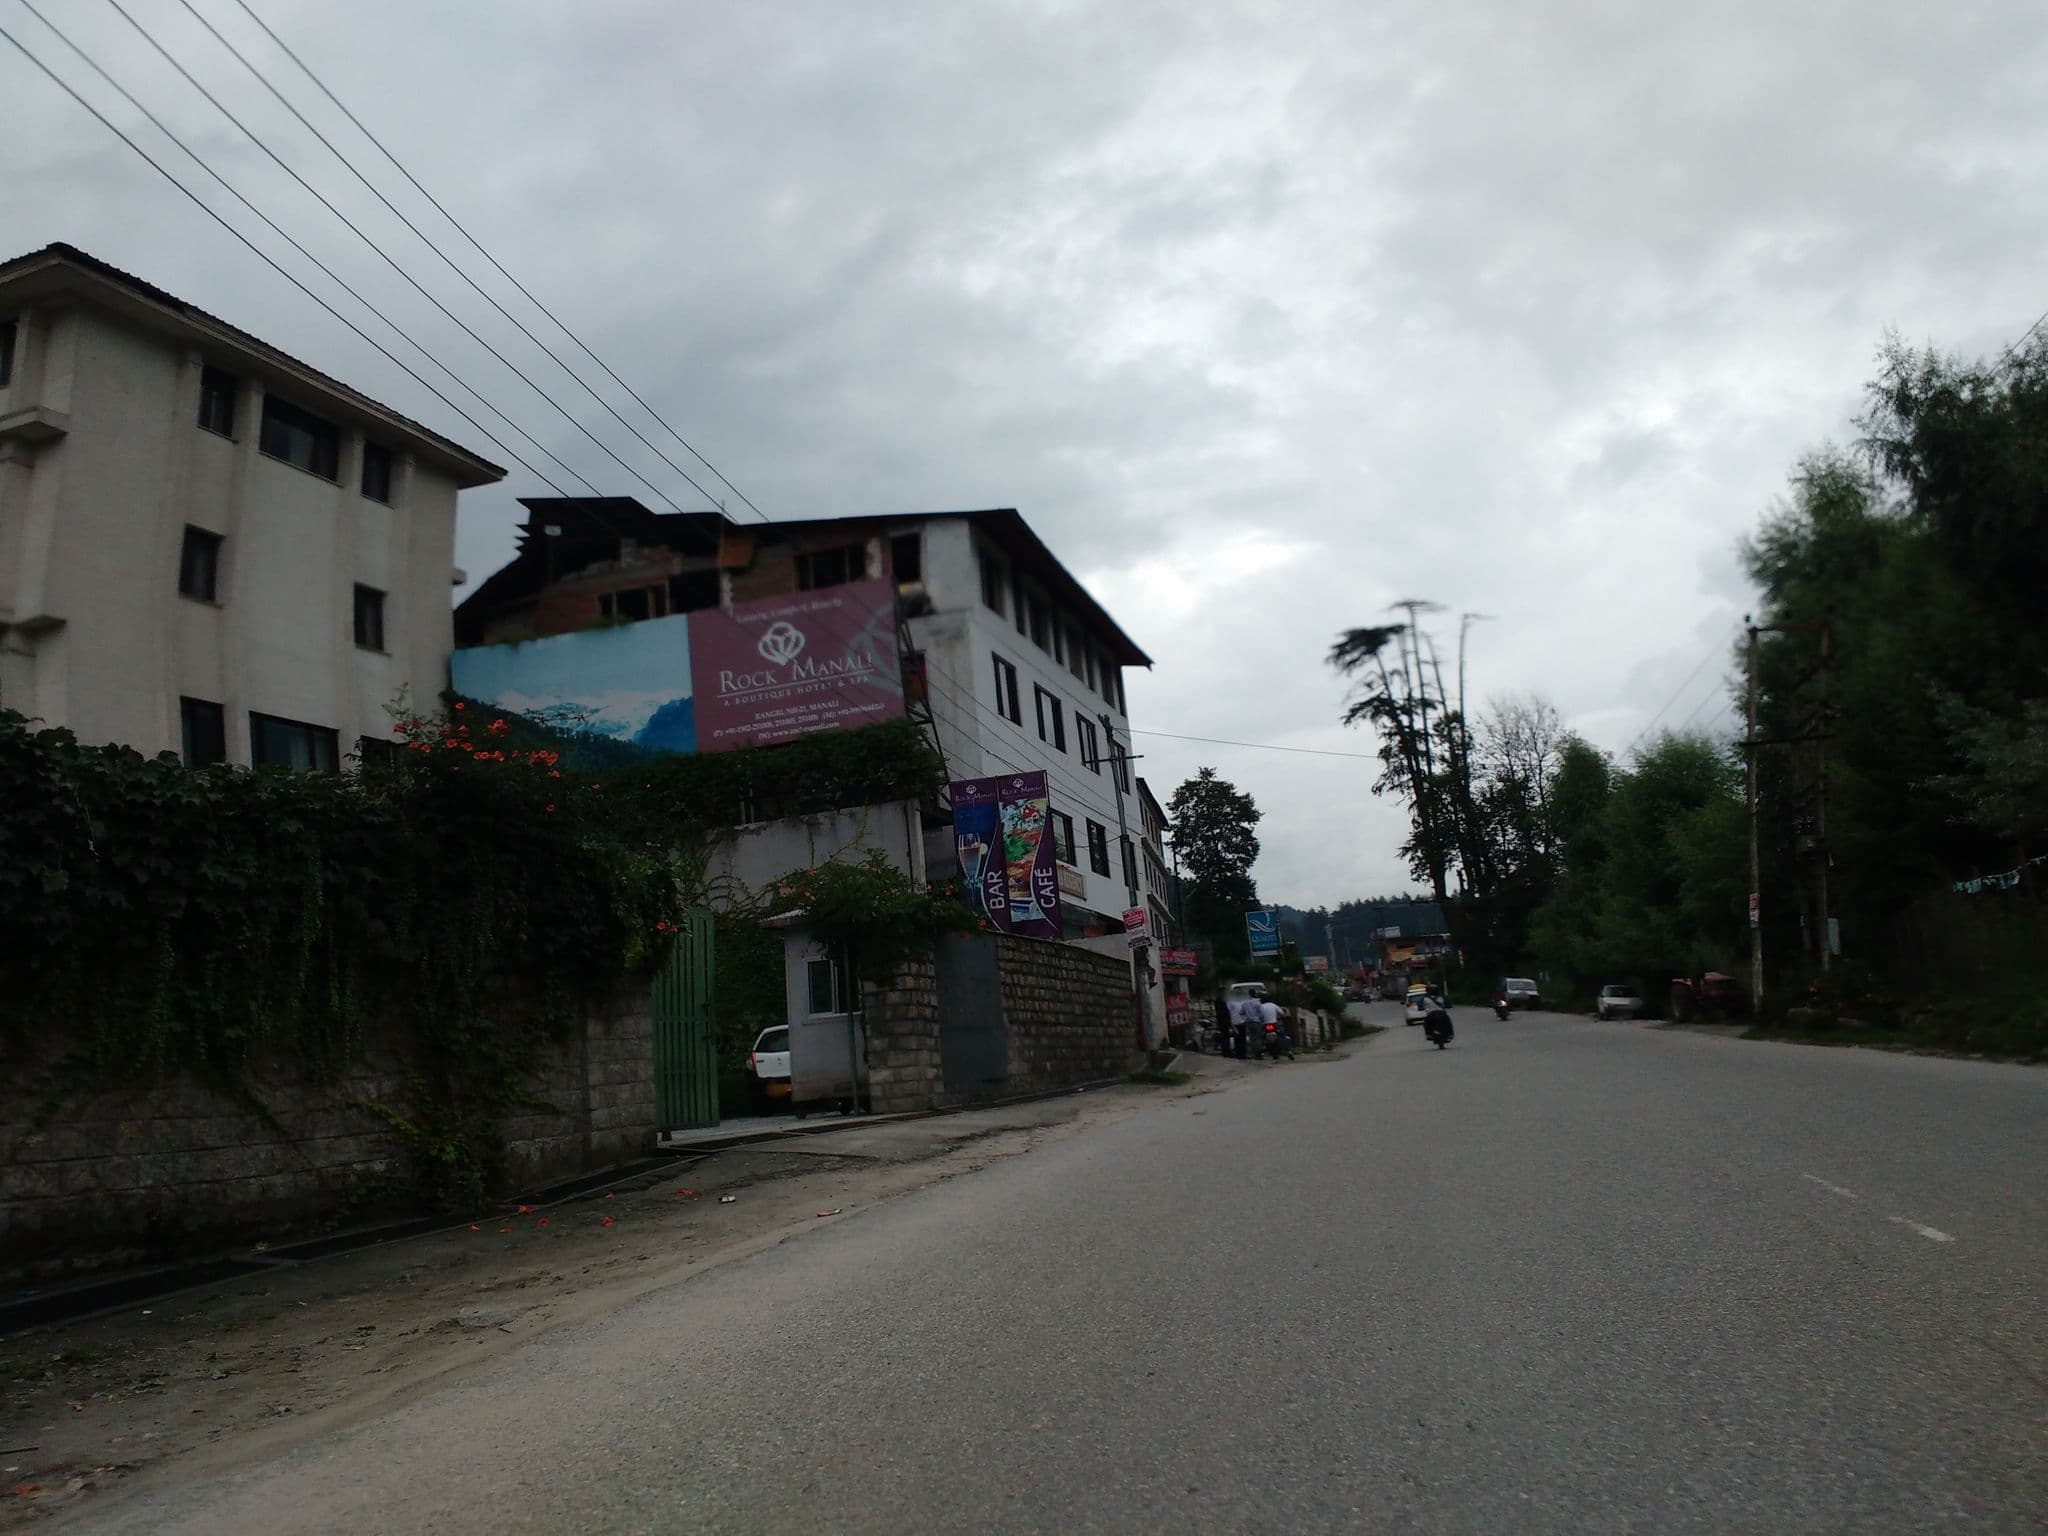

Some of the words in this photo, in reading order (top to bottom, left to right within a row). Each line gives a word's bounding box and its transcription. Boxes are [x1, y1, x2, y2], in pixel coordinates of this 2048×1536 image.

[720, 670, 777, 693] ROCK
[793, 653, 872, 680] MANALI
[736, 689, 792, 705] BOUTIQUE
[808, 699, 840, 713] MANALI
[987, 870, 1005, 909] BAR
[1034, 867, 1056, 908] CAFÉ
